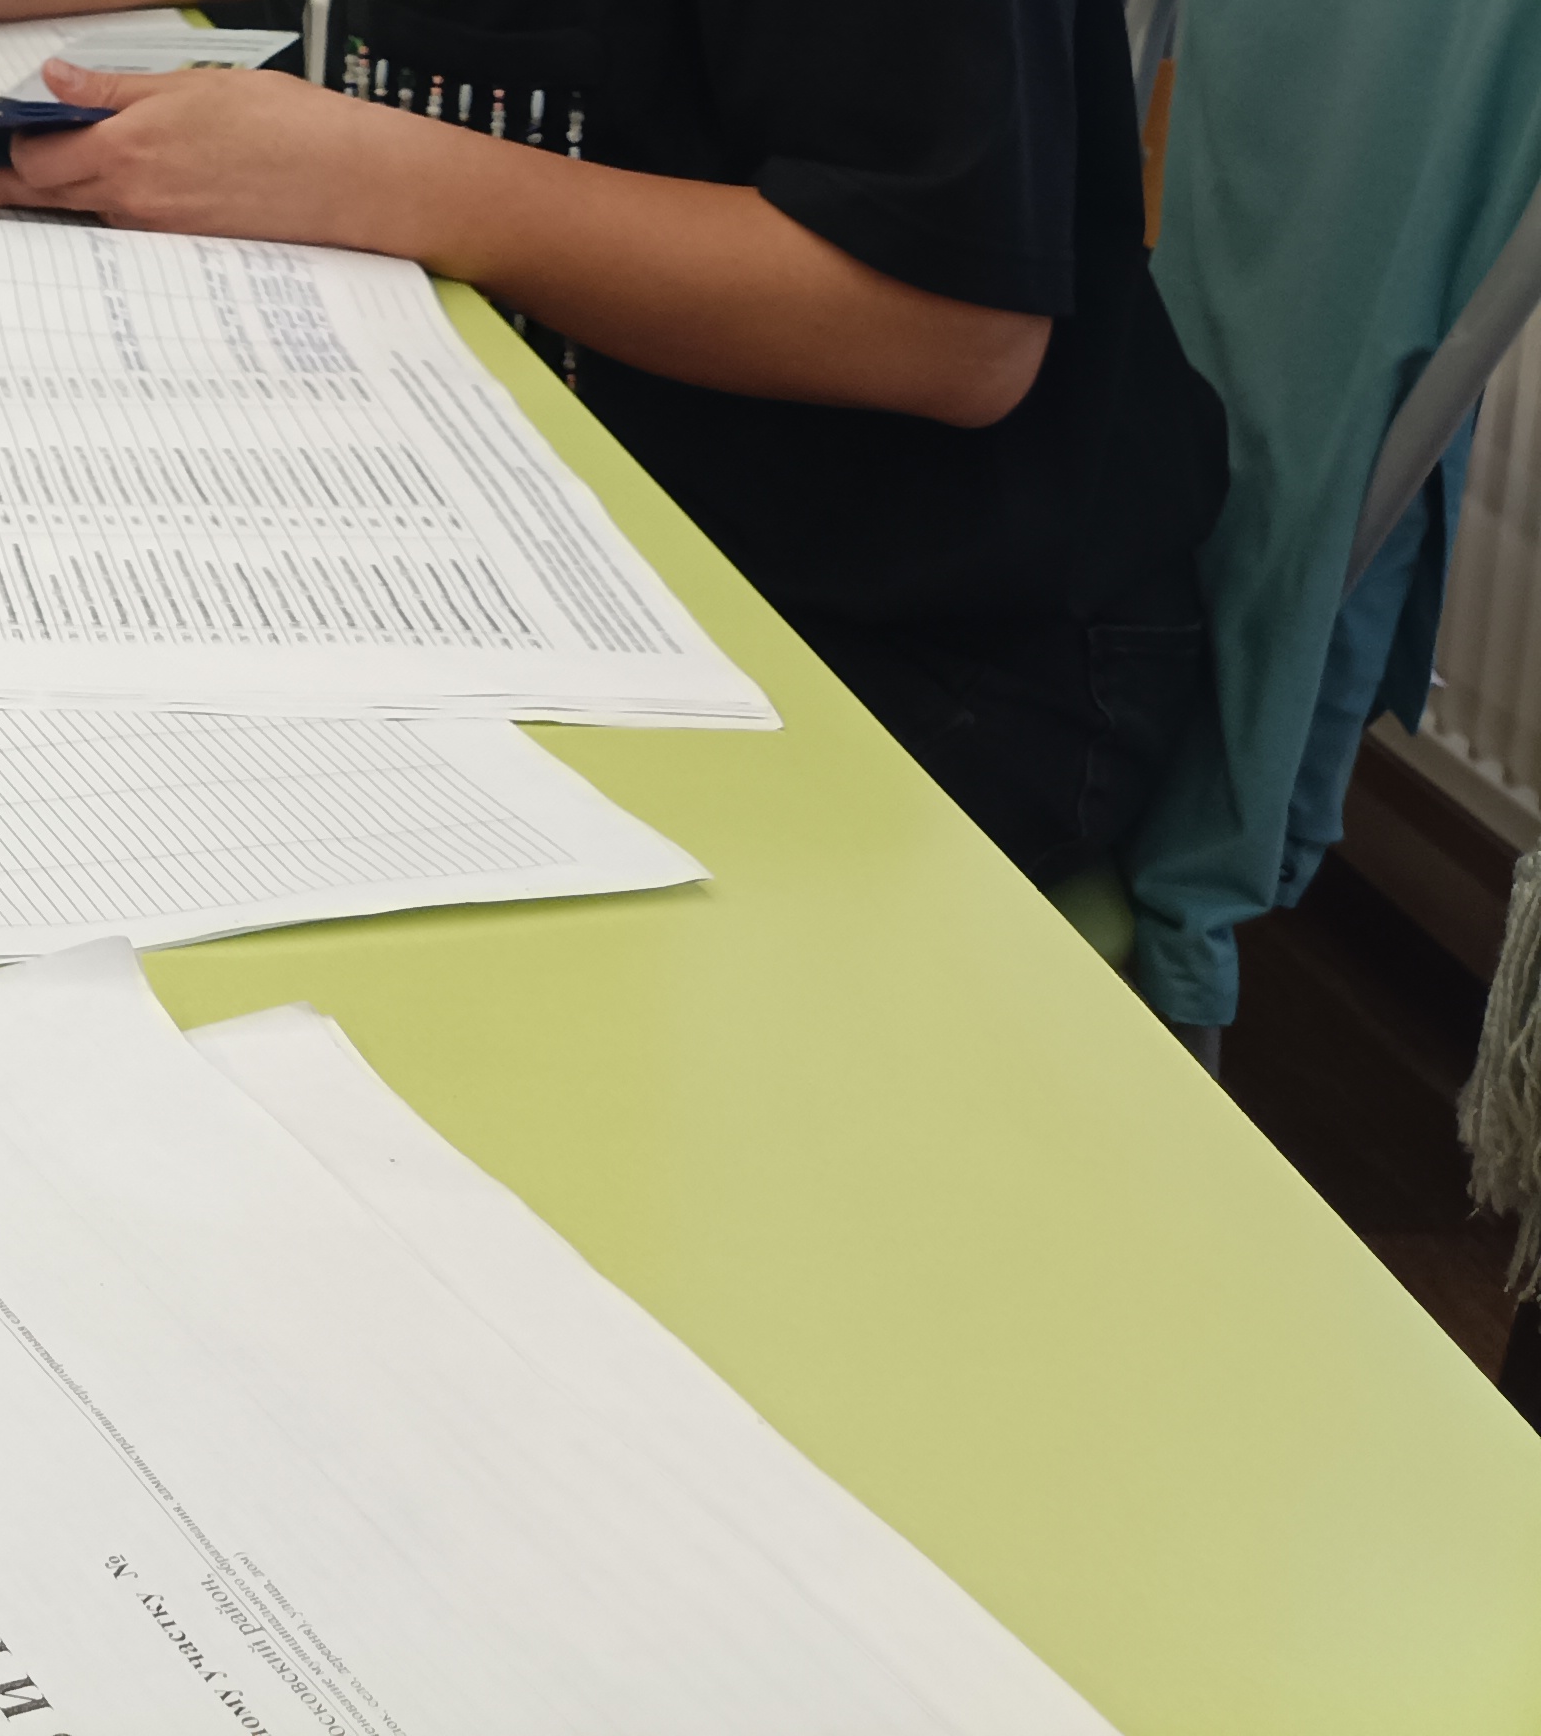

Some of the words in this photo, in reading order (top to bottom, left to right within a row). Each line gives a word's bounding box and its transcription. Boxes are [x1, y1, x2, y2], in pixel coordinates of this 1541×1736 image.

[105, 1555, 138, 1579] №
[137, 1594, 227, 1682] участку
[201, 1574, 263, 1635] район,
[235, 1578, 322, 1675] муниципального
